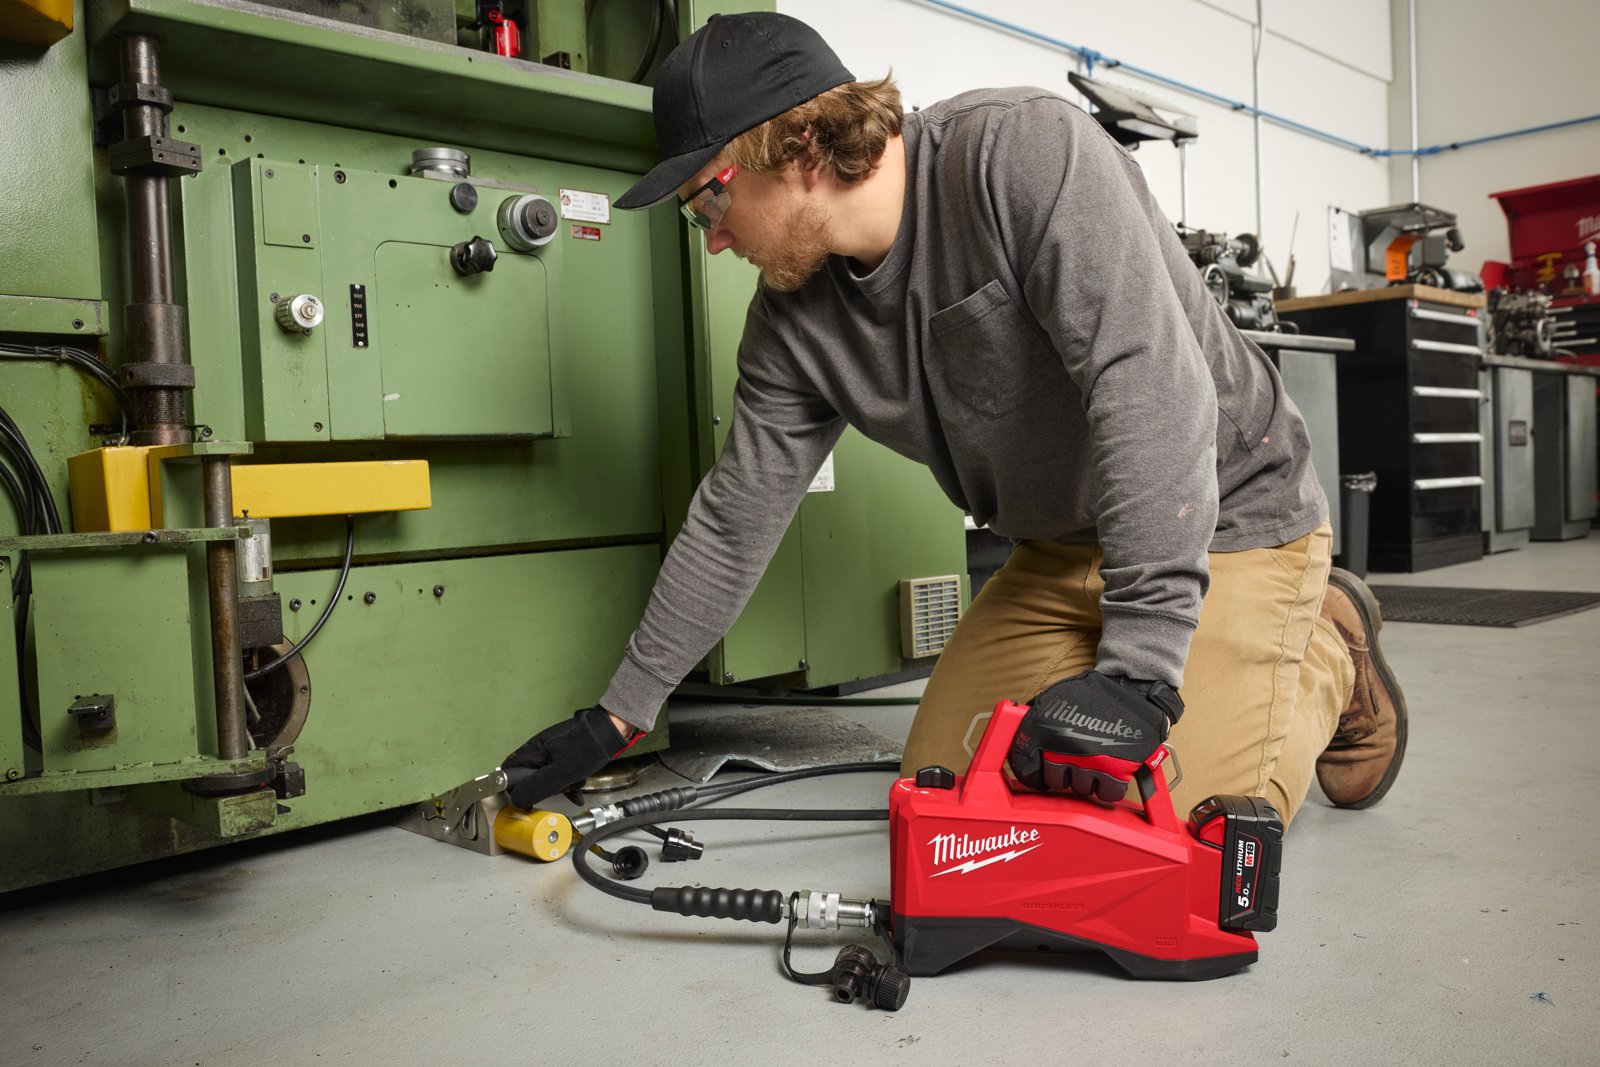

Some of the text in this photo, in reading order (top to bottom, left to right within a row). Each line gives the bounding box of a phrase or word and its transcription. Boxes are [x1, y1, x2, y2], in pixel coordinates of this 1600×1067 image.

[1044, 696, 1144, 740] Milwaukee
[926, 826, 1041, 866] Milwaukee
[1235, 840, 1244, 894] REDLITHIUM
[1245, 843, 1255, 866] M18
